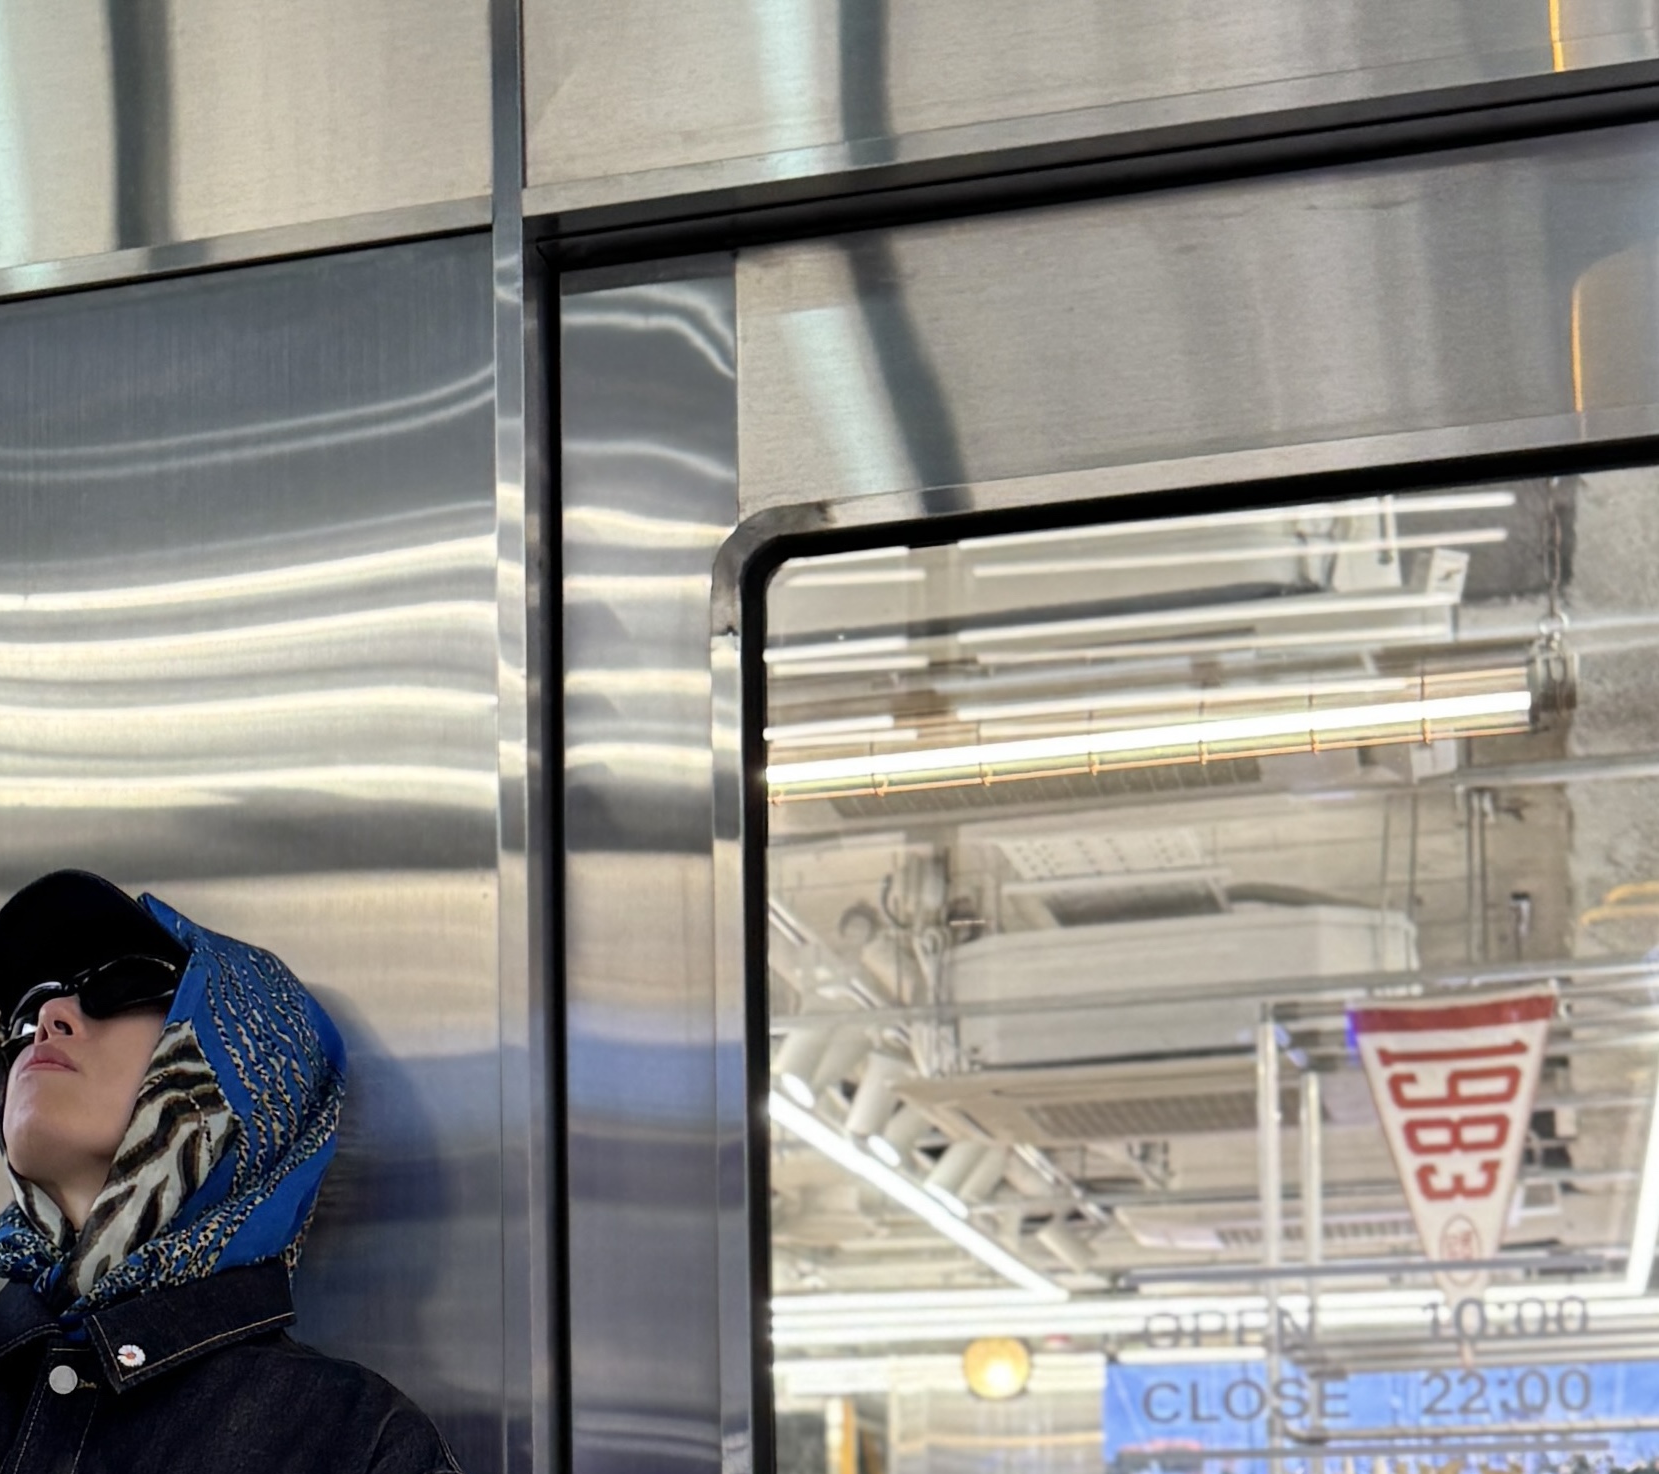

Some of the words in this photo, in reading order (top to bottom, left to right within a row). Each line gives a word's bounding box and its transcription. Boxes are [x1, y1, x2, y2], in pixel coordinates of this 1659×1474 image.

[1377, 1040, 1529, 1201] 1983
[1144, 1304, 1316, 1352] OPEN
[1421, 1296, 1589, 1340] 10:00
[1143, 1376, 1350, 1425] CLOSE
[1421, 1369, 1591, 1416] 22:00
